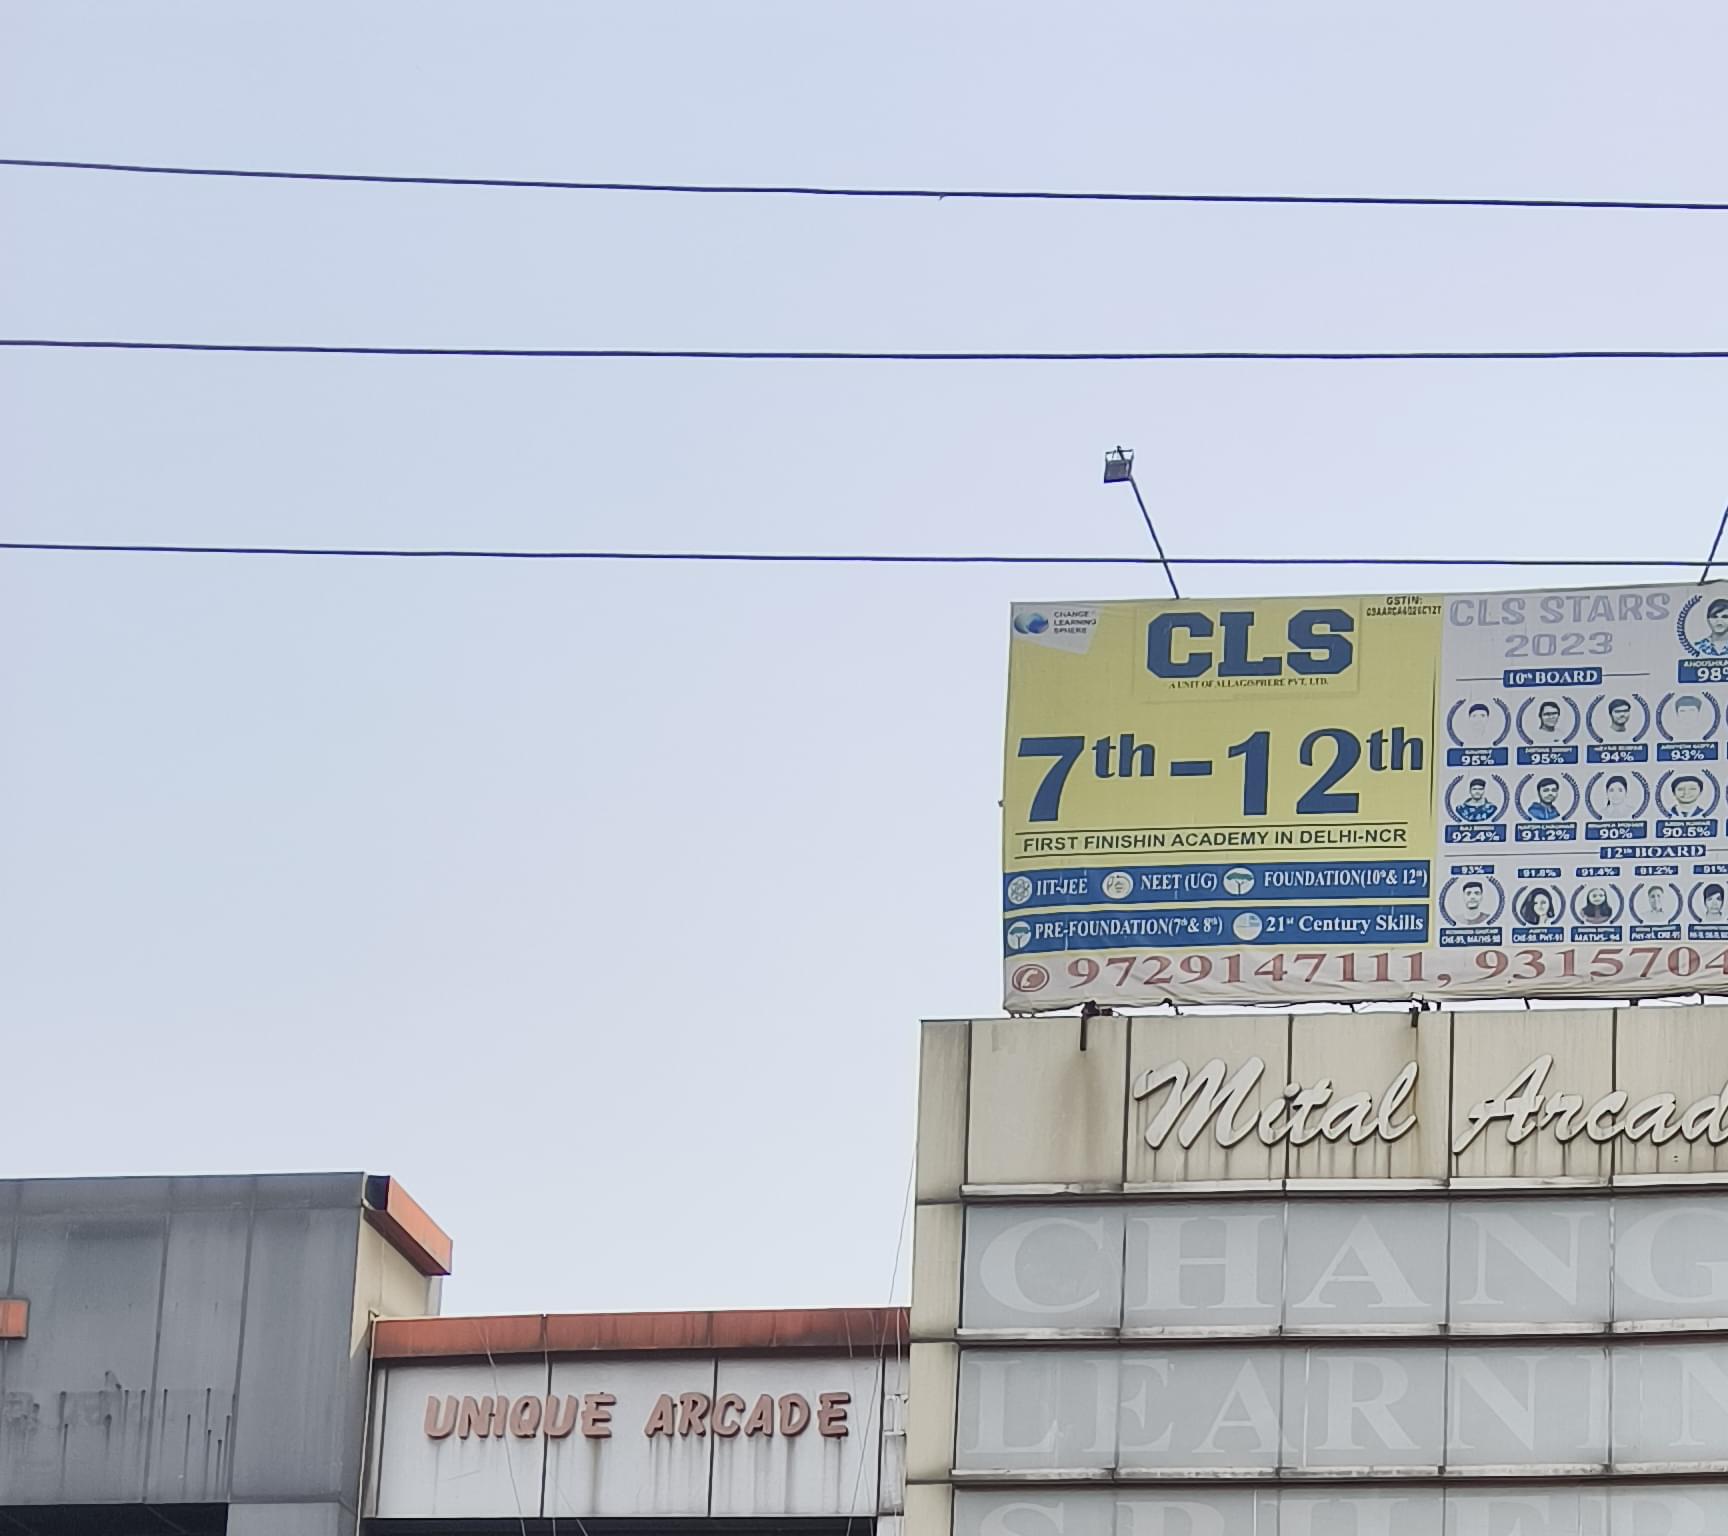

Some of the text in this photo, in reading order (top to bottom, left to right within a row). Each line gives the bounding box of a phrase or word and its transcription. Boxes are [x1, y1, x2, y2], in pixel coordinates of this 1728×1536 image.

[1449, 593, 1671, 627] CLS STARS
[1147, 609, 1355, 678] CLS
[1504, 632, 1614, 658] 2023
[1535, 669, 1597, 684] BOARD
[1023, 828, 1407, 853] FIRST FINISHIN ACADEMY DELHI-NCR
[1140, 874, 1181, 891] NEET
[1300, 913, 1424, 935] Century Skills
[1133, 1056, 1420, 1150] Mital
[424, 1391, 853, 1439] UNIQUE ARCADE
